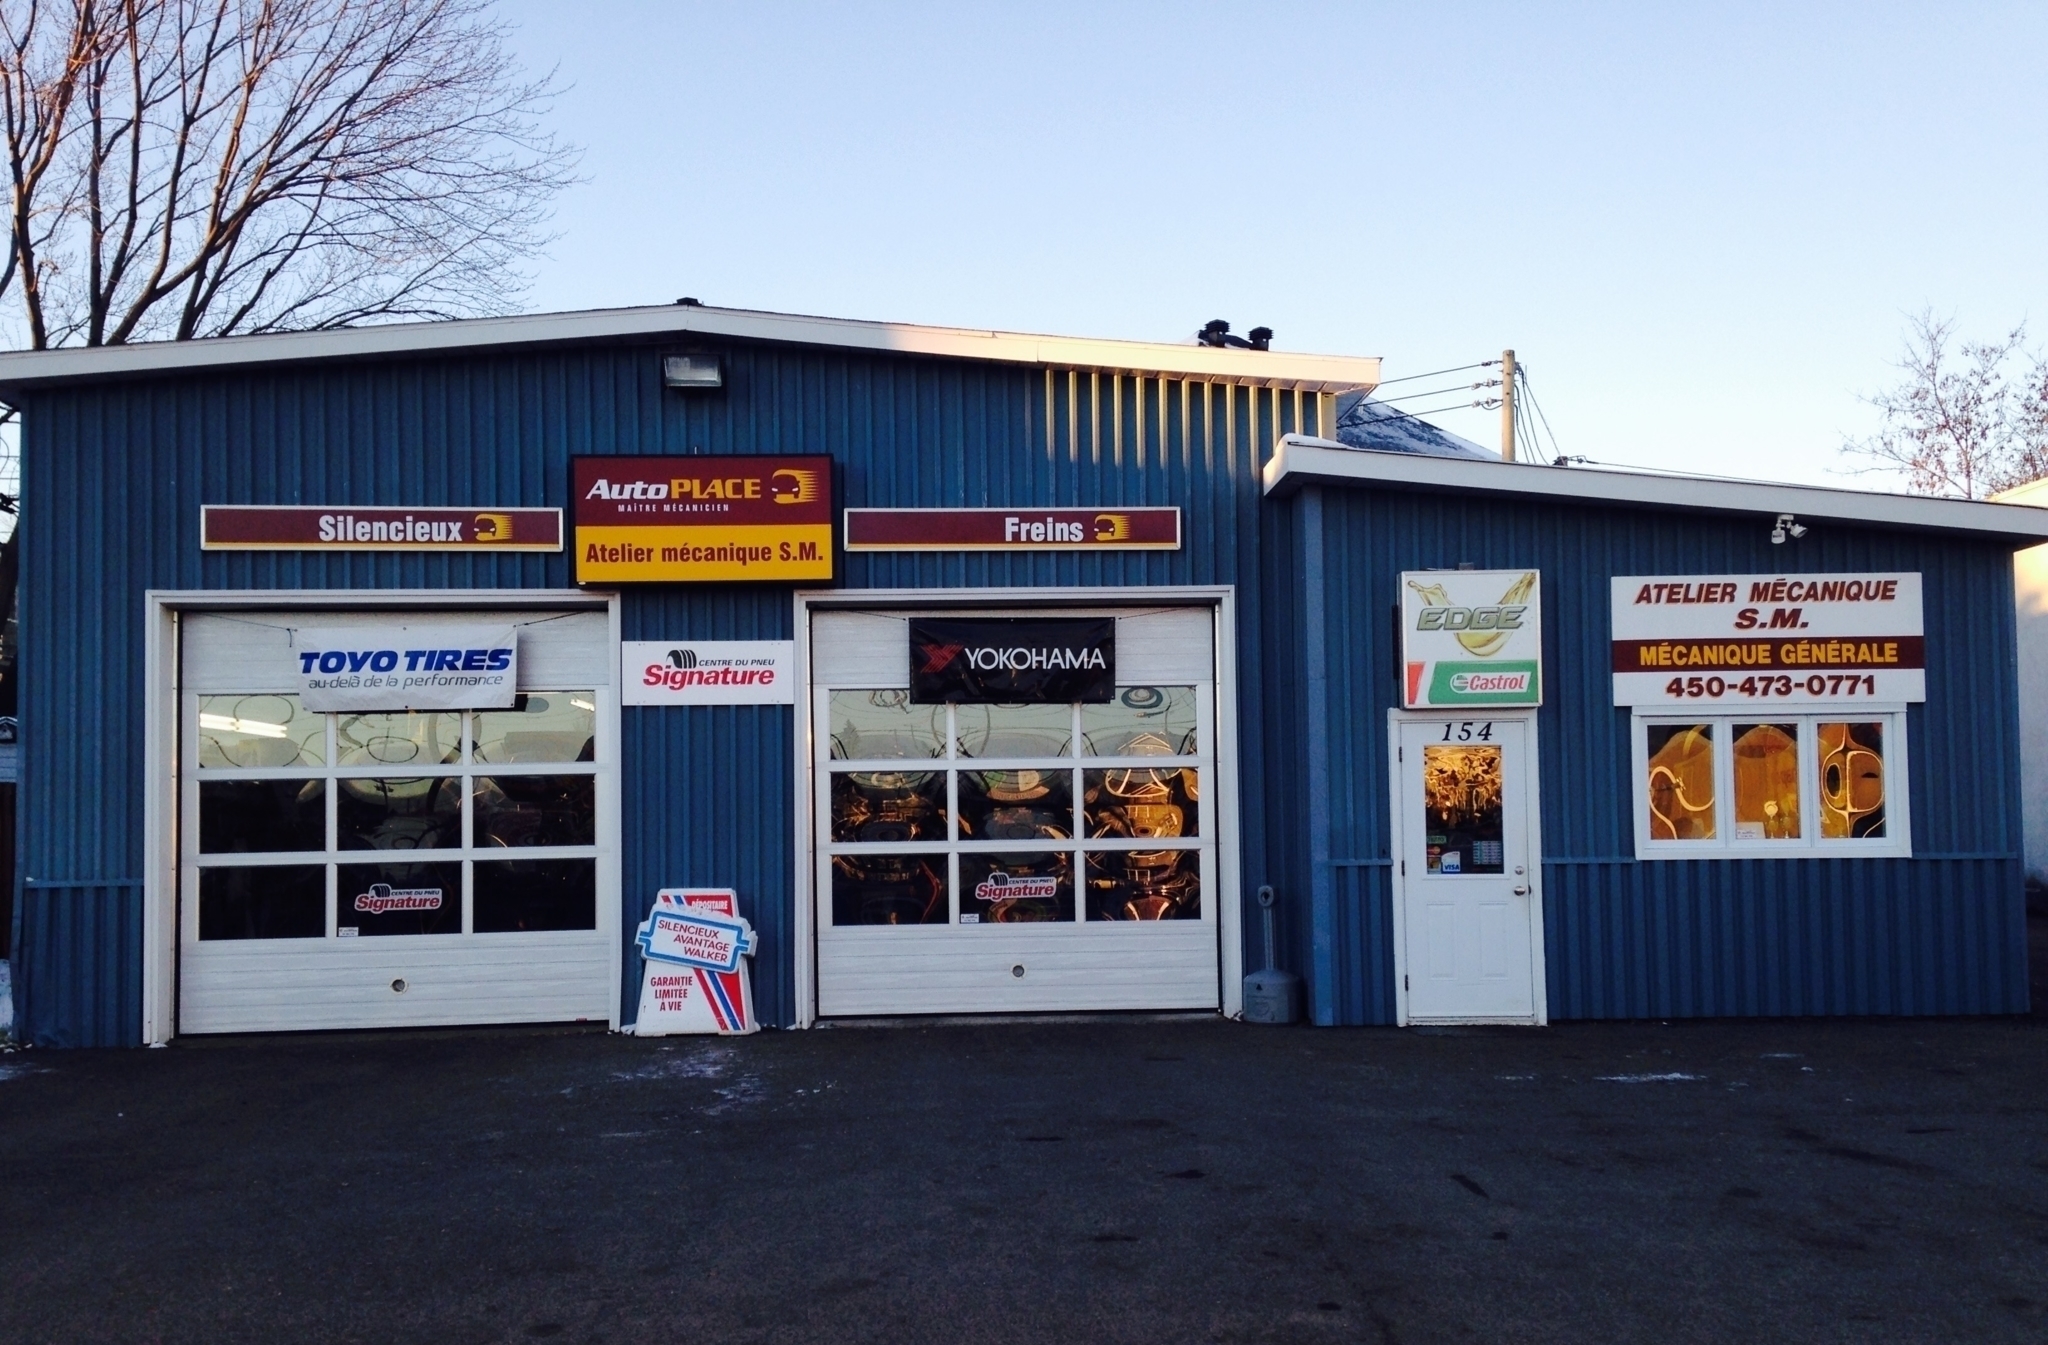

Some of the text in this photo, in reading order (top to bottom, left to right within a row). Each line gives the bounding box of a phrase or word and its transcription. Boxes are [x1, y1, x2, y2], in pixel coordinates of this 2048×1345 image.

[663, 502, 729, 512] MÉCANICIEN
[319, 514, 463, 543] Silencieux
[1005, 517, 1084, 542] Freins
[586, 541, 823, 566] Atelier mécanique S.M.
[1634, 578, 1898, 604] ATELIER MÉCANIQUE
[1417, 605, 1528, 631] EDGE
[1734, 608, 1809, 629] S.M.
[300, 648, 513, 673] TOYO TIRES
[698, 659, 733, 667] CENTRE
[750, 658, 775, 666] PNEU
[965, 648, 1106, 670] YOKOHAMA
[1640, 640, 1898, 666] MÉCANIQUE GÉNÉRALE
[308, 673, 503, 690] au-delà de la performance
[643, 664, 775, 691] Signature
[1469, 674, 1525, 690] Castrol
[1666, 674, 1875, 697] 450-473-0771
[1442, 721, 1493, 741] 154
[976, 884, 1054, 900] Signature
[356, 895, 440, 912] Signature
[658, 919, 720, 939] SILENCIEUX
[673, 934, 730, 952] AVANTAGE
[684, 946, 728, 962] WALKER
[650, 976, 693, 987] GARANTIE
[654, 986, 688, 999] LIMITÉE
[660, 997, 682, 1011] À VIE
